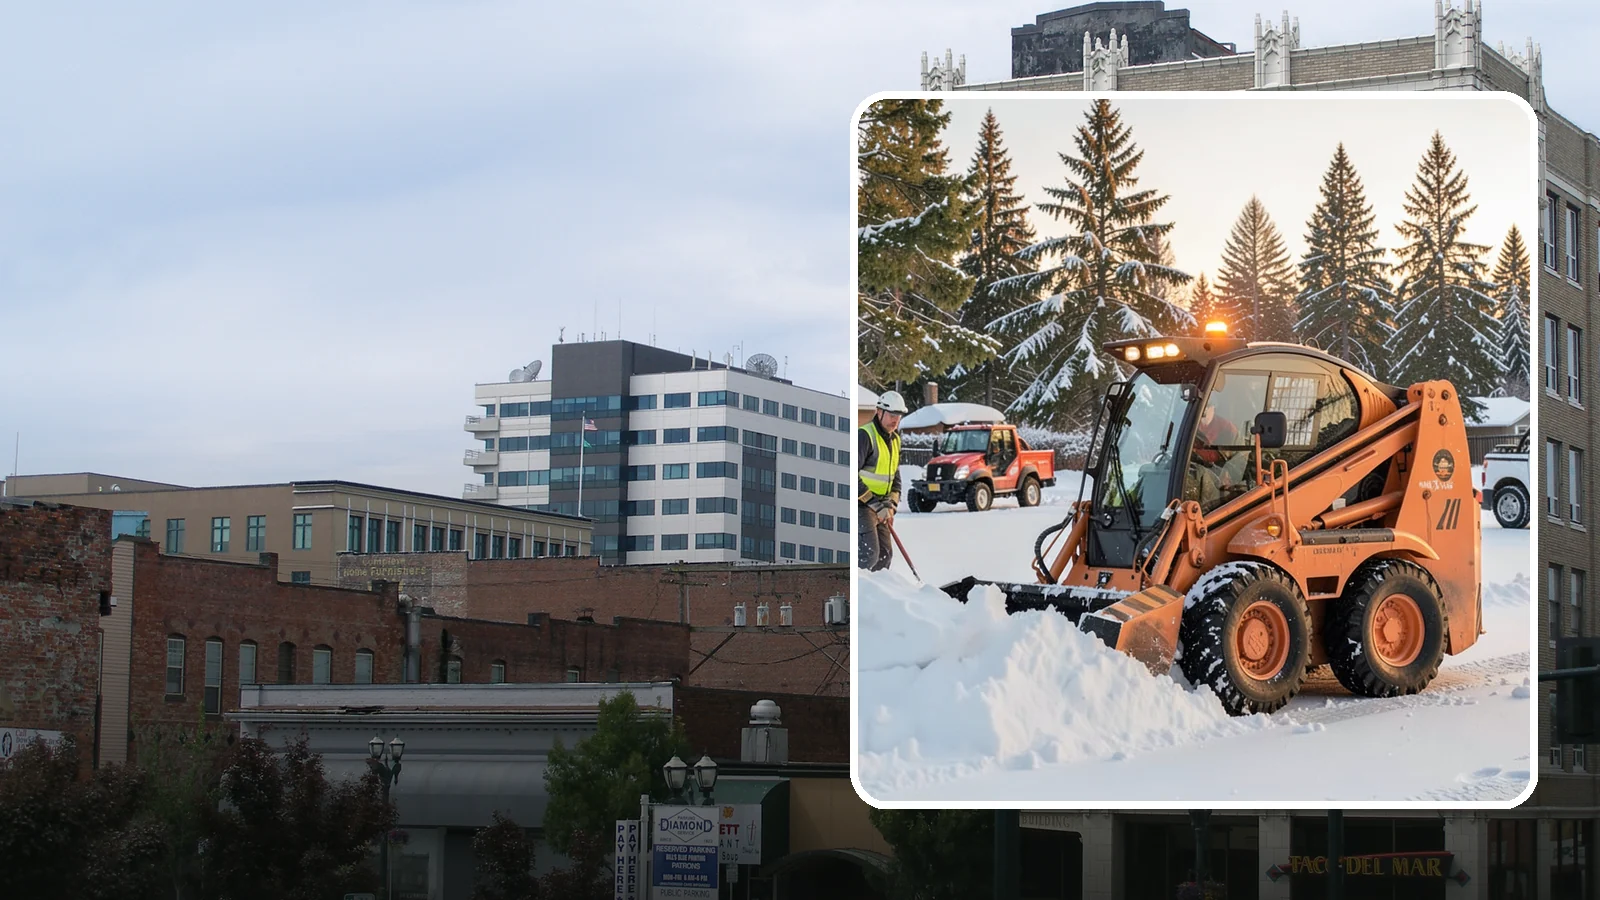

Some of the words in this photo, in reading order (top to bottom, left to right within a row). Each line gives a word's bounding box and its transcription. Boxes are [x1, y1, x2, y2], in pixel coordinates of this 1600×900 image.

[343, 567, 367, 577] Home
[370, 566, 426, 576] Furnishers
[1022, 815, 1069, 828] BUILDING
[689, 846, 716, 854] PARKING
[722, 852, 739, 862] Soup
[671, 862, 701, 870] PATRONS
[1346, 856, 1385, 875] DEL
[1392, 857, 1442, 876] MAR
[660, 889, 682, 897] PUBLIC
[684, 889, 710, 898] PARKING
